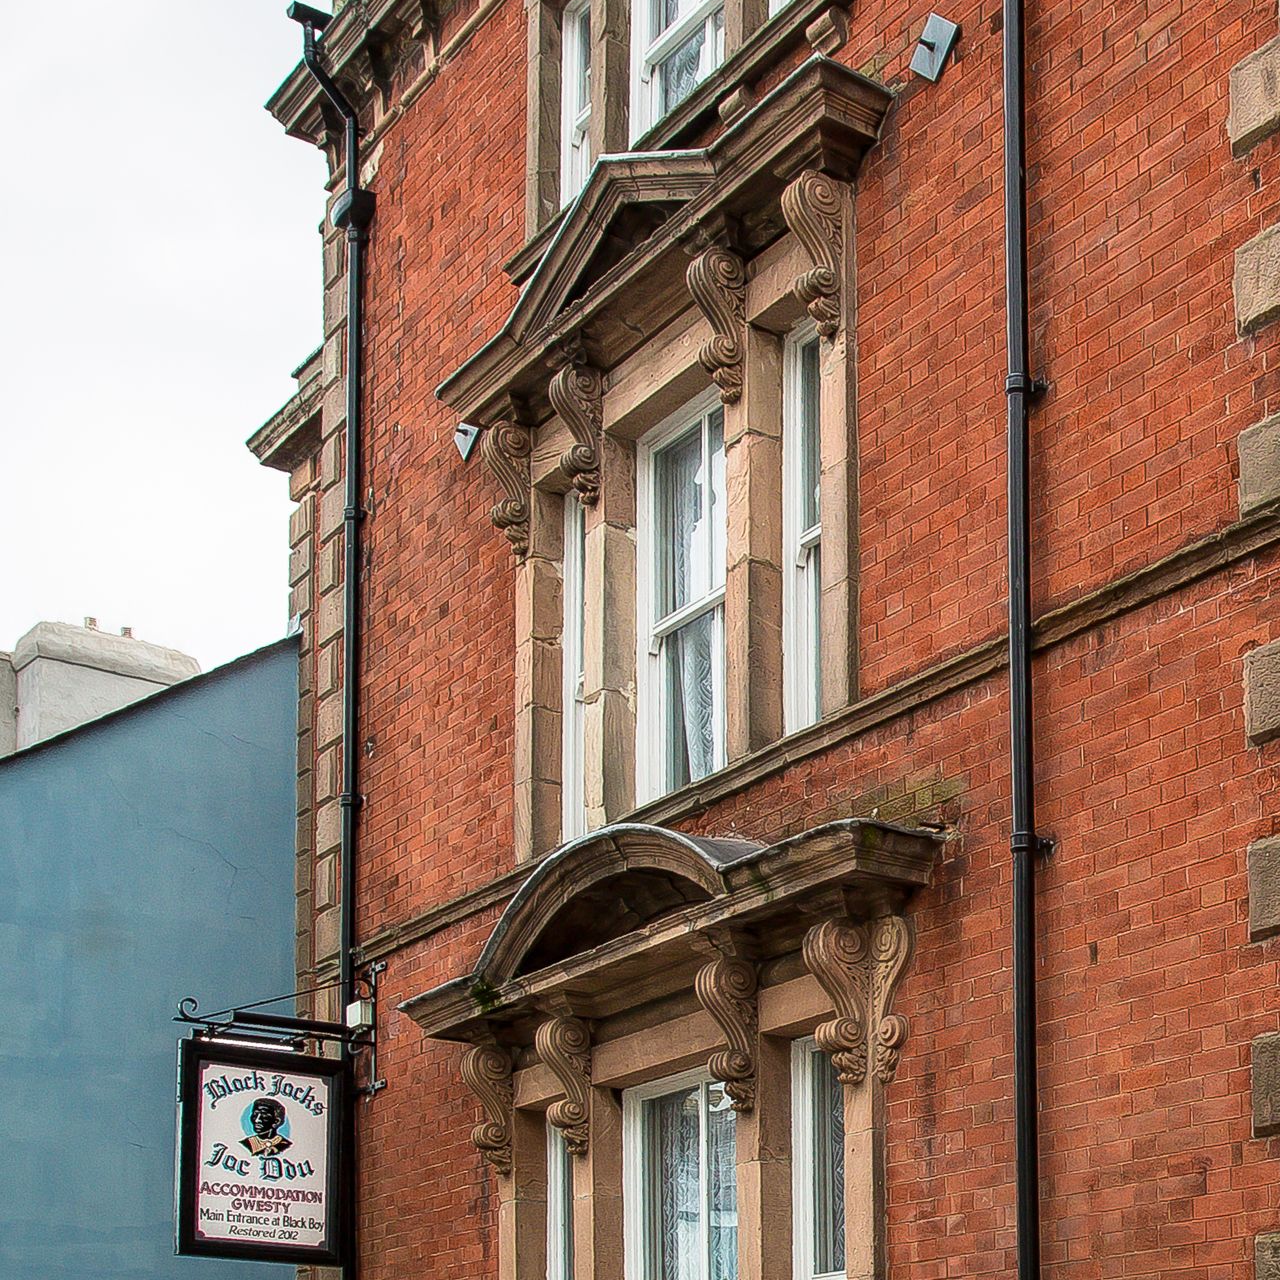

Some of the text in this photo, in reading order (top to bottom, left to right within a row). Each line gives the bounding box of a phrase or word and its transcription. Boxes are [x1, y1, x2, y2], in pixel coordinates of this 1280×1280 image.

[204, 1071, 265, 1110] Black
[260, 1156, 315, 1182] Ddu
[200, 1182, 322, 1204] ACCOMMODATION
[232, 1198, 292, 1213] GWESTY
[200, 1208, 324, 1232] Main Entrance at Black Boy
[228, 1226, 299, 1240] Restored 2012
